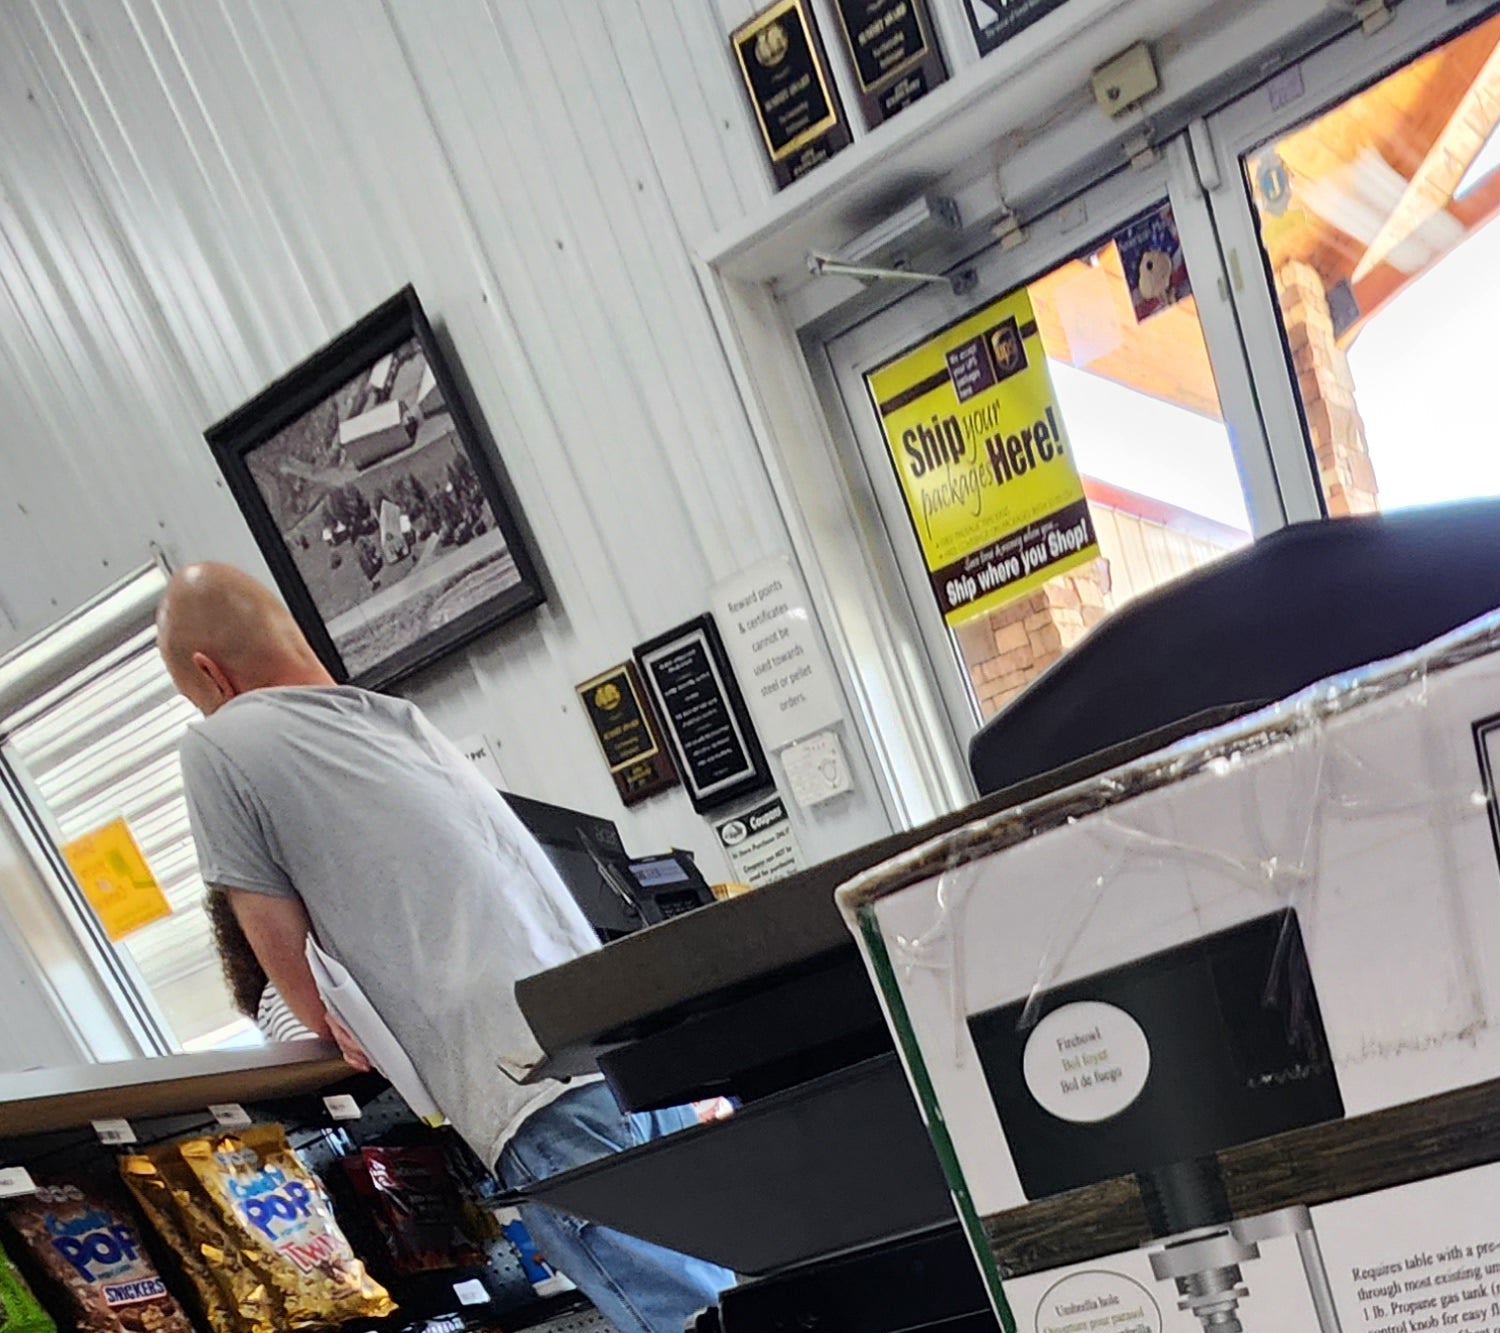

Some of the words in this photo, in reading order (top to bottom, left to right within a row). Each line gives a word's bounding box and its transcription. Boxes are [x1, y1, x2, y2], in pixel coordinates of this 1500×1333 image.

[902, 414, 966, 478] Ship
[962, 398, 1001, 466] your
[985, 406, 1064, 487] Here!
[920, 461, 994, 541] packages
[946, 576, 976, 606] Ship
[978, 559, 1021, 592] where
[1020, 543, 1048, 576] you
[1048, 518, 1089, 558] Shop!
[243, 1180, 312, 1241] POP
[53, 1223, 138, 1283] POP
[1351, 1258, 1404, 1285] Requires
[1403, 1251, 1434, 1270] table
[1435, 1244, 1464, 1263] with
[105, 1278, 165, 1302] SNICKERS
[1356, 1279, 1403, 1305] through
[1402, 1273, 1433, 1291] most
[1388, 1293, 1438, 1319] Propane
[1438, 1292, 1461, 1309] gas
[1459, 1283, 1488, 1301] tank
[1407, 1314, 1441, 1332] knob
[1440, 1310, 1461, 1326] for
[1459, 1309, 1489, 1327] easy
